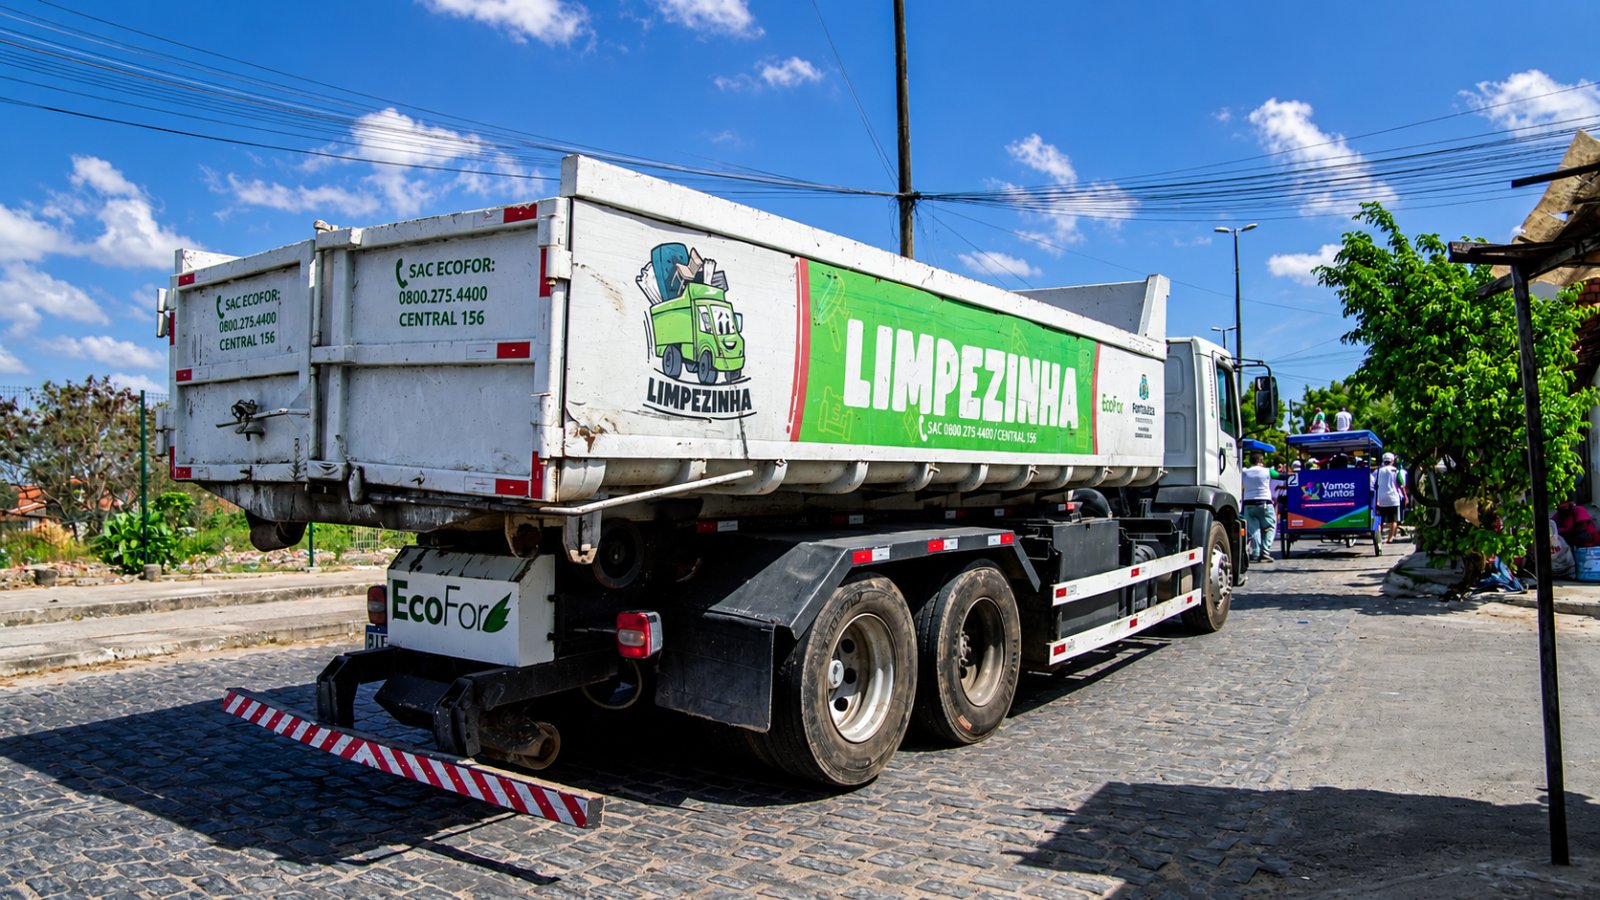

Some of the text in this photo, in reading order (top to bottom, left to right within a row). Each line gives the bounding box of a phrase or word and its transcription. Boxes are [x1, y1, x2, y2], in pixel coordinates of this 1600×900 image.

[409, 258, 495, 278] SAC ECOFOR:
[225, 289, 280, 311] SAC ECOFOR:
[399, 286, 487, 305] 0800.275.4400
[219, 311, 277, 333] 0800.275.4400
[399, 310, 485, 327] CENTRAL 156
[220, 331, 276, 351] CENTRAL 156
[843, 318, 1079, 430] LIMPEZINHA
[646, 376, 752, 413] LIMPEZINHA
[927, 421, 943, 435] SAC
[943, 423, 962, 437] 0800
[962, 425, 976, 438] 275
[1289, 473, 1298, 486] 2
[1321, 482, 1355, 490] Vamos
[1322, 490, 1355, 499] Juntos
[392, 579, 489, 631] EcoFor
